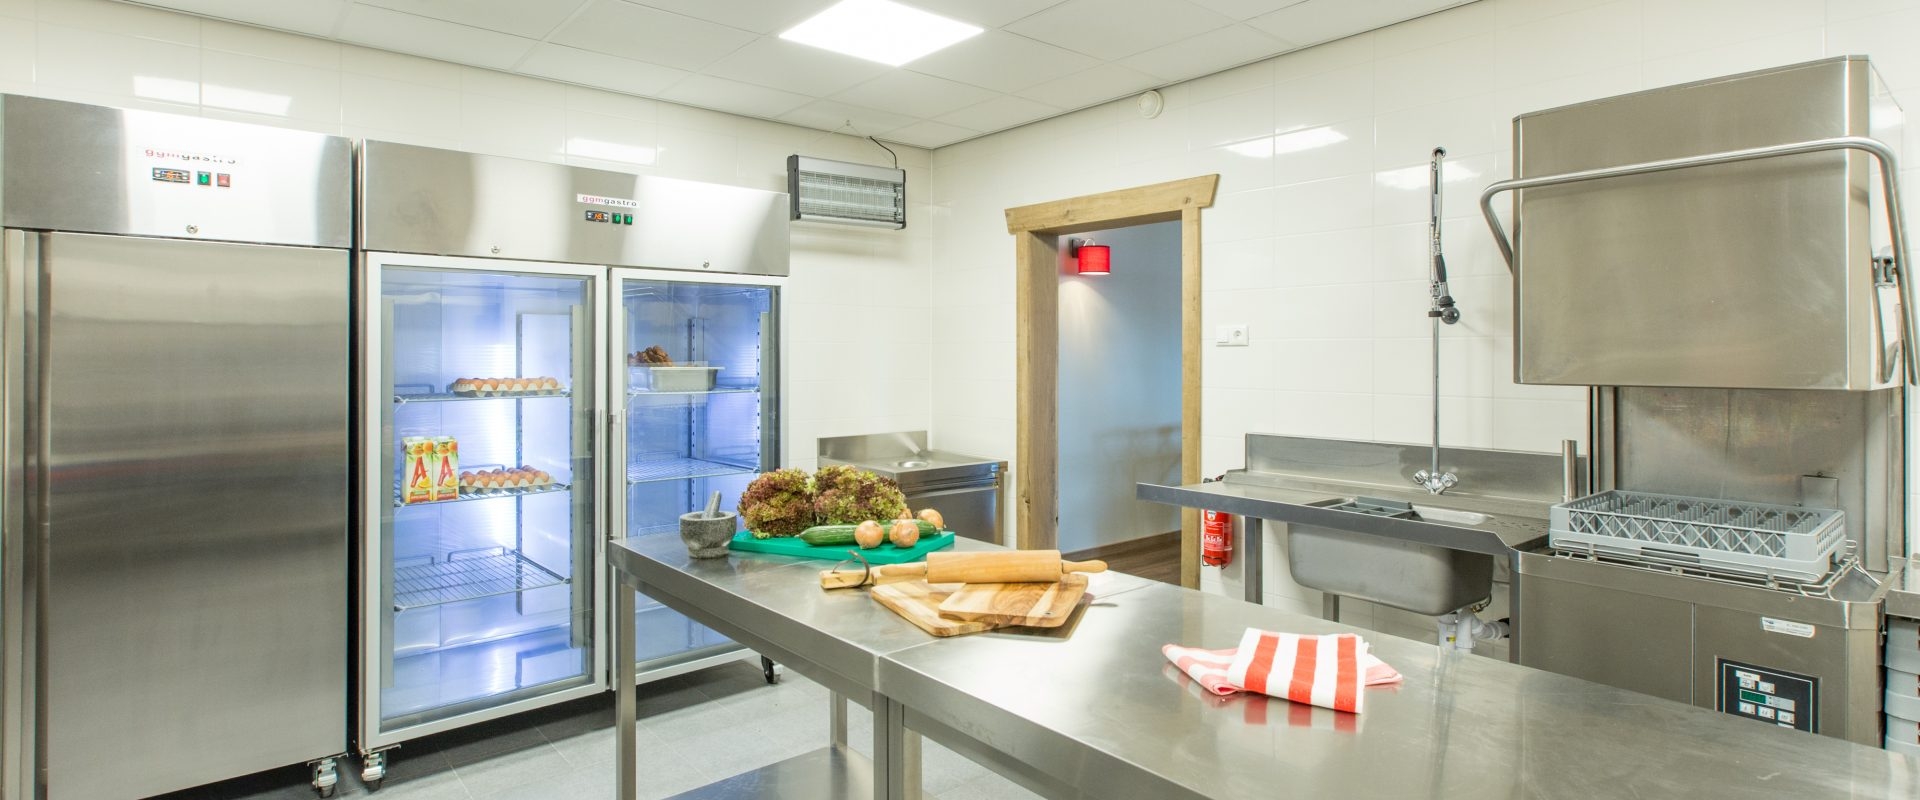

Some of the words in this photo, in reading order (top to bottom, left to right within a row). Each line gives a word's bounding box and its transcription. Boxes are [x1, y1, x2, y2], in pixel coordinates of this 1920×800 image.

[582, 196, 637, 207] ggmgastro
[410, 456, 428, 488] A
[437, 455, 454, 487] A
